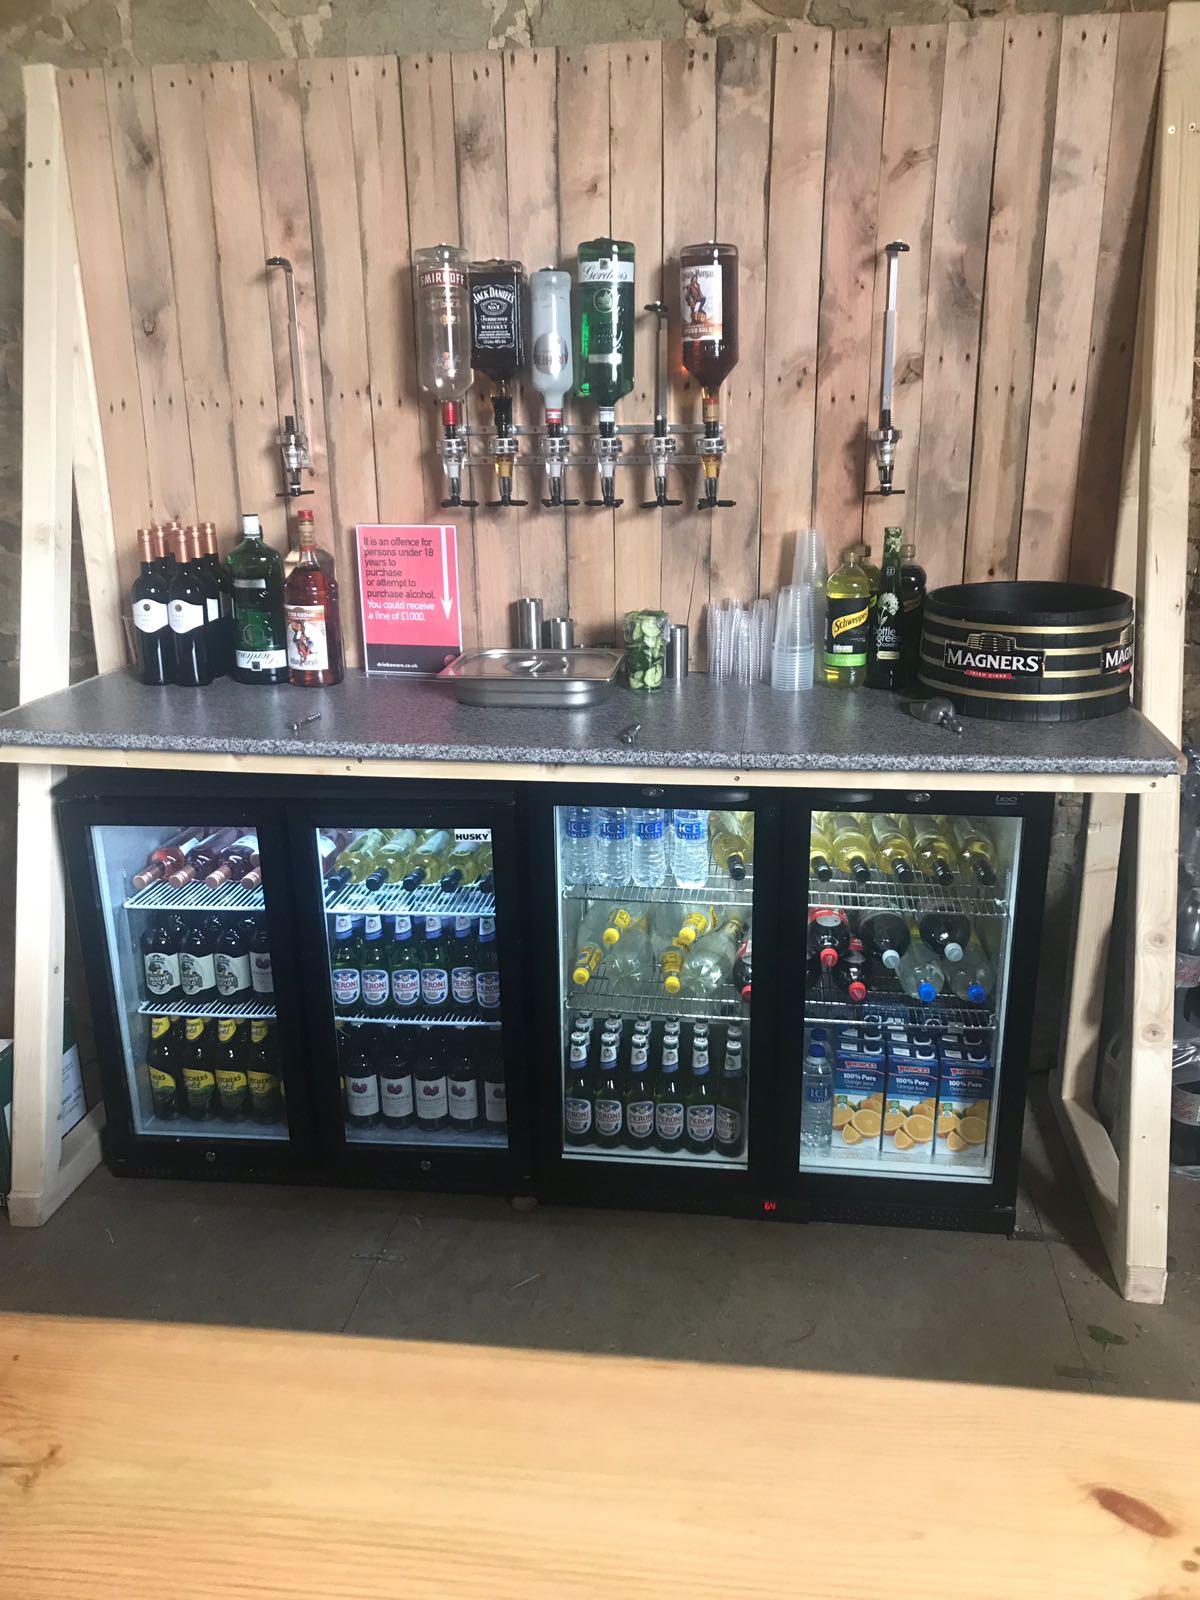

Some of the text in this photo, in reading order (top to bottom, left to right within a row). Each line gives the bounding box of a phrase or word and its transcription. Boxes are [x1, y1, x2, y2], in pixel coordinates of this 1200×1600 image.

[420, 271, 465, 286] SMIROFF
[473, 290, 489, 304] JACK
[489, 286, 514, 304] DANIEL'S
[364, 537, 369, 546] It
[371, 538, 377, 546] is
[391, 537, 419, 546] offence
[421, 537, 432, 546] for
[364, 548, 433, 558] persons under 18
[365, 558, 396, 569] years to
[365, 569, 402, 578] purchase
[376, 579, 407, 589] attempt
[408, 579, 416, 587] to
[367, 590, 436, 599] purchase alcohol.
[367, 600, 435, 610] You could receive
[375, 611, 390, 620] fine
[391, 611, 400, 620] of
[947, 648, 1039, 672] MAGNERS
[568, 822, 588, 832] ICE
[602, 822, 621, 833] ICE
[640, 822, 662, 834] ICE
[679, 822, 699, 834] ICE
